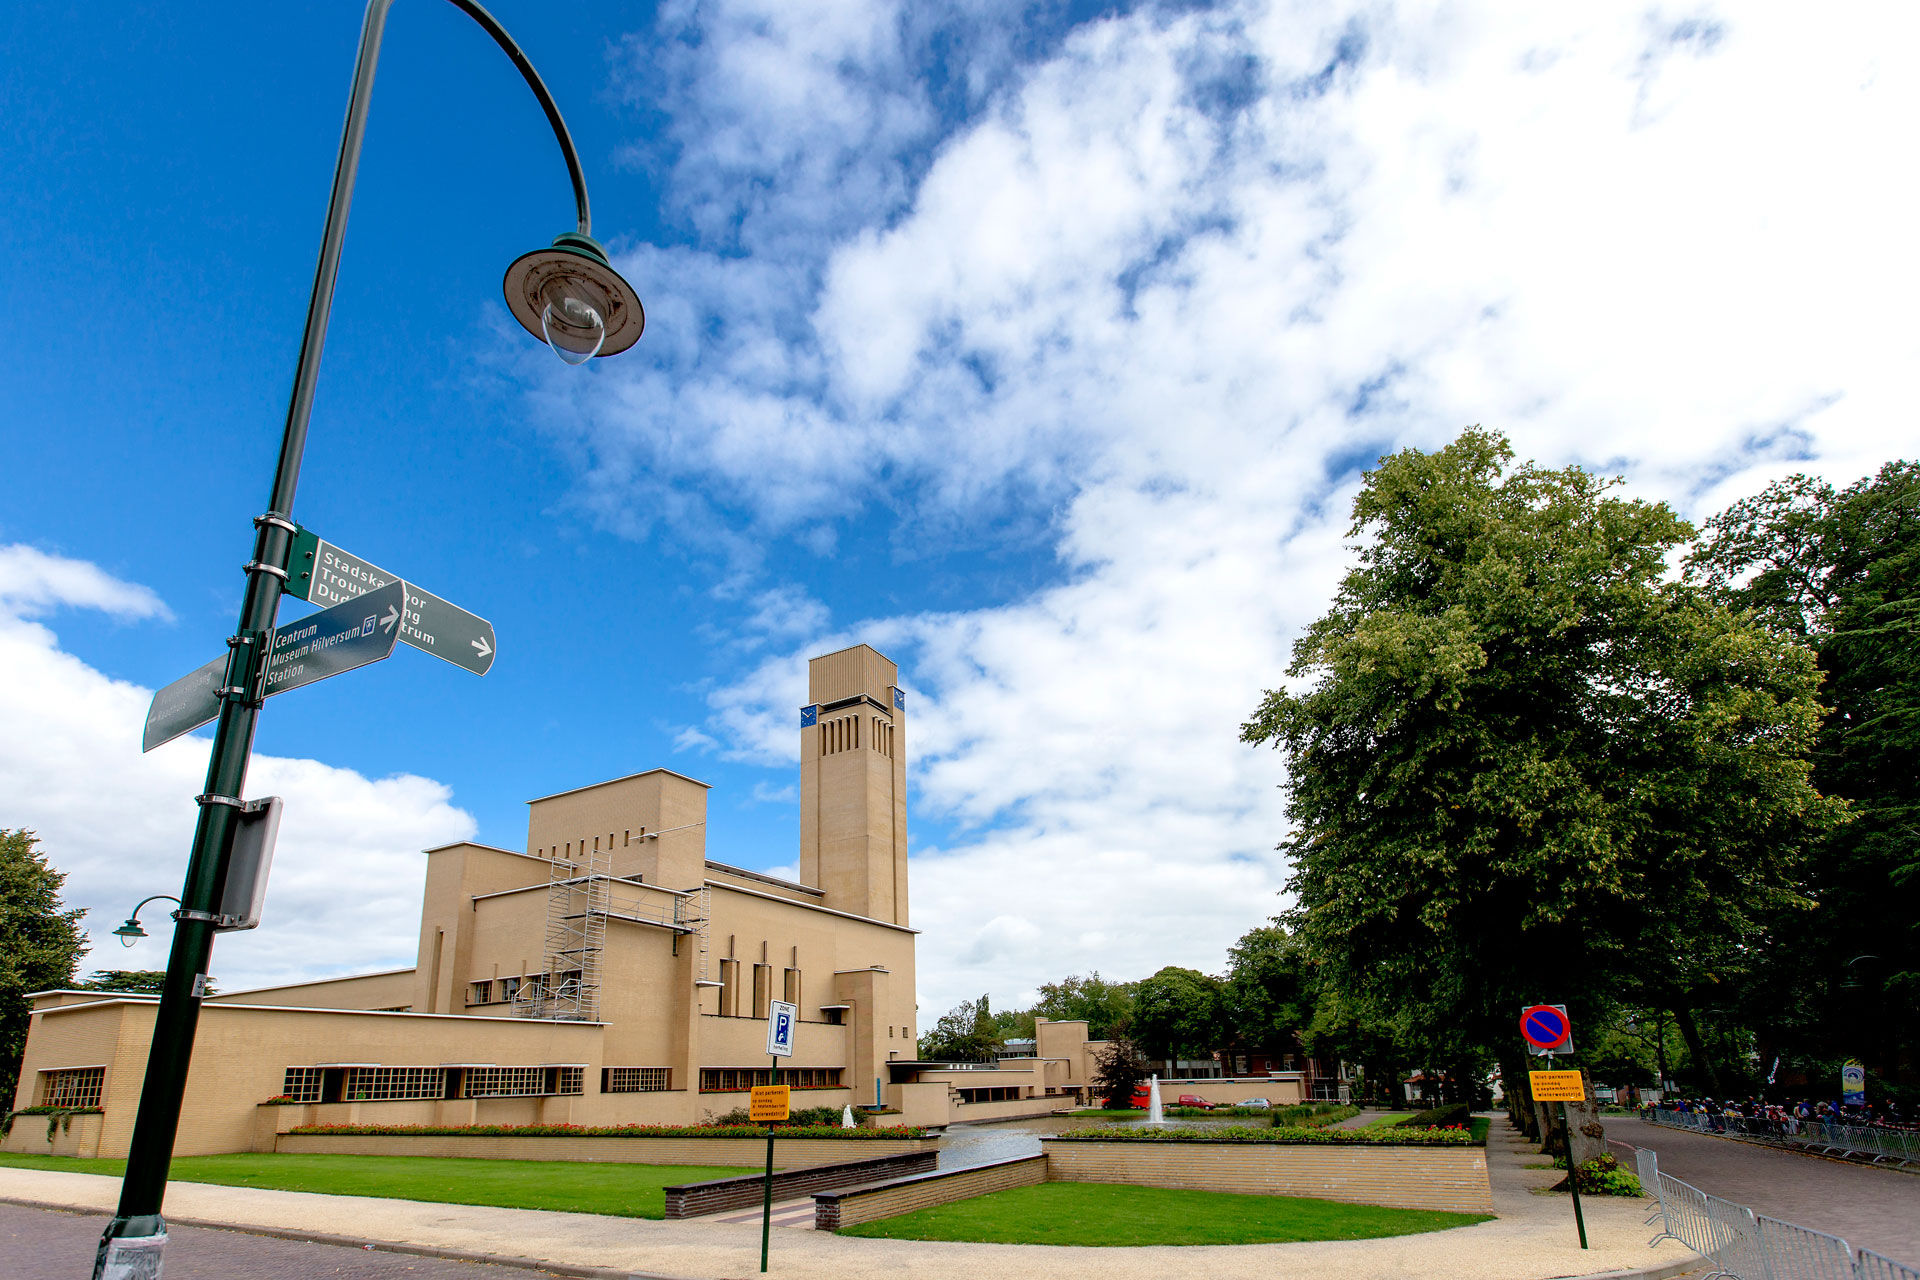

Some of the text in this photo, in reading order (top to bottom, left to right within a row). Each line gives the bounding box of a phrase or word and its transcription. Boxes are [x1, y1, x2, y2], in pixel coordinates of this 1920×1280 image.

[271, 626, 360, 667] Museum Hilversum
[275, 624, 318, 648] Centrum
[267, 664, 304, 685] Station
[779, 1005, 790, 1013] ZONE
[779, 1016, 788, 1031] P
